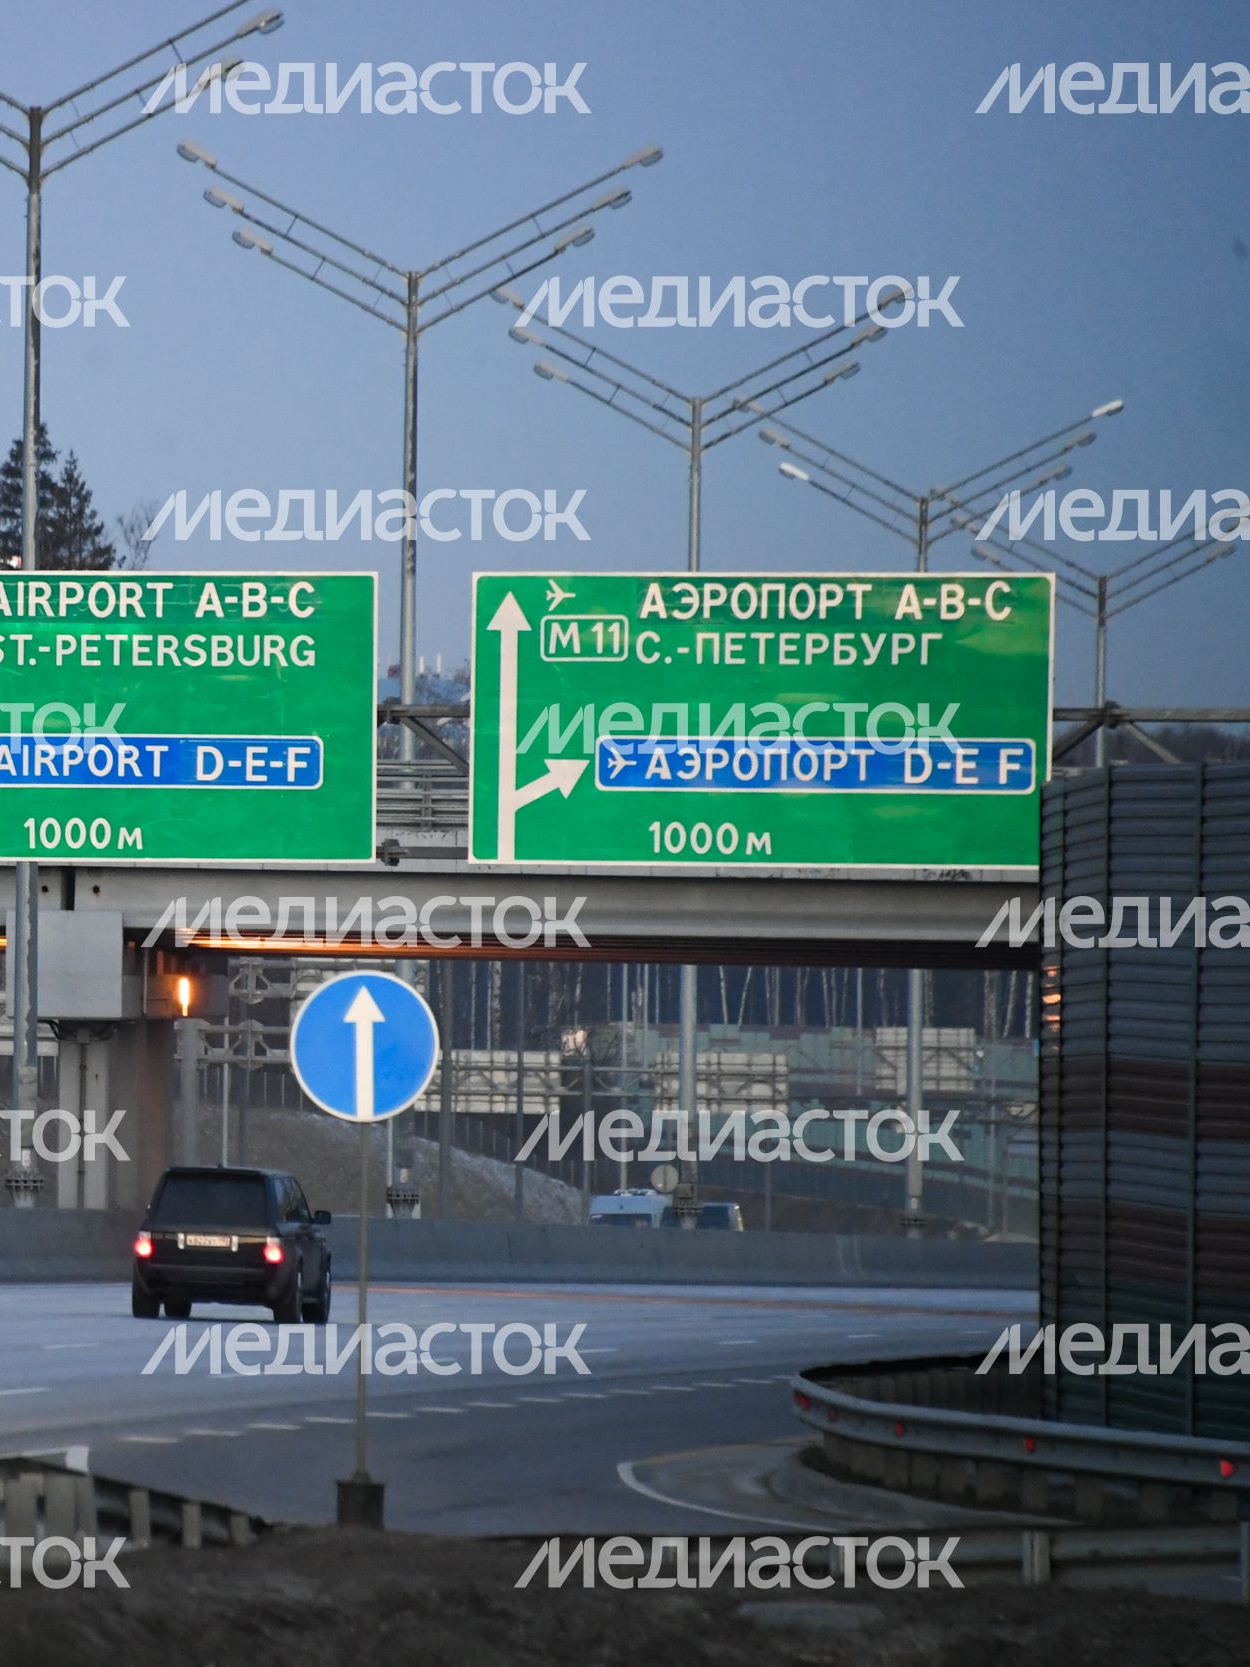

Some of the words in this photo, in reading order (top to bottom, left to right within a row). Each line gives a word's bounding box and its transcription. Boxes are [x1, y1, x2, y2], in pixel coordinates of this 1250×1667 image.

[195, 580, 316, 618] A-B-C
[639, 582, 871, 620] АЭРОПОРТ
[196, 745, 311, 782] D-E-F
[645, 747, 876, 781] АЭРОПОРТ
